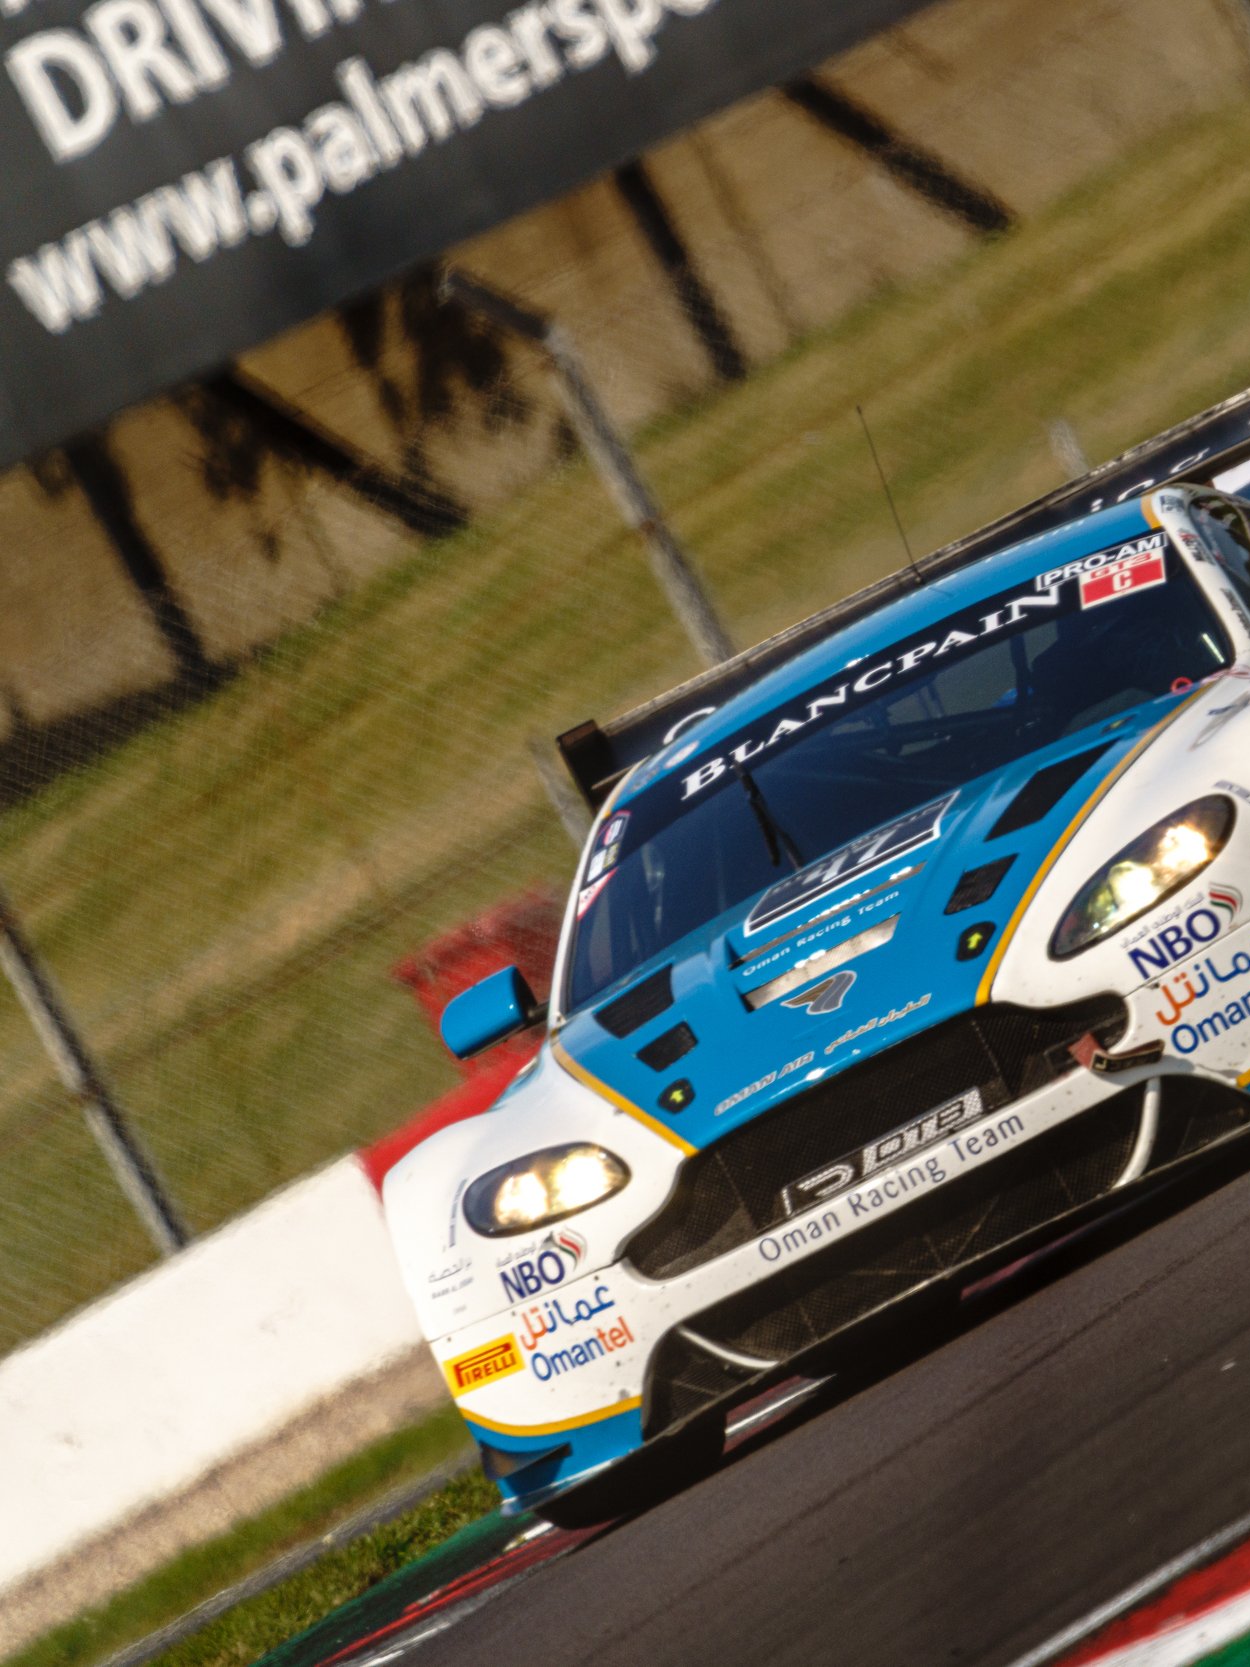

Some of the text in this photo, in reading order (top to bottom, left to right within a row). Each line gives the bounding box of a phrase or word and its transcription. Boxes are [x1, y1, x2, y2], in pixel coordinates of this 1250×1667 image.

[3, 0, 398, 165] DRIV
[7, 0, 718, 334] www.palmersp
[1043, 535, 1162, 587] PRO-AM
[1090, 552, 1151, 577] GT3
[1112, 571, 1132, 589] C
[682, 586, 1059, 801] BLANCPAIN
[741, 888, 900, 977] Oman Racing Team
[1127, 907, 1221, 980] NBO
[715, 1051, 816, 1116] OMAN AIR
[758, 1114, 1026, 1263] Oman Racing Team
[500, 1250, 566, 1303] NBO
[454, 1341, 517, 1388] PIRELLI
[530, 1316, 634, 1382] Omantel
